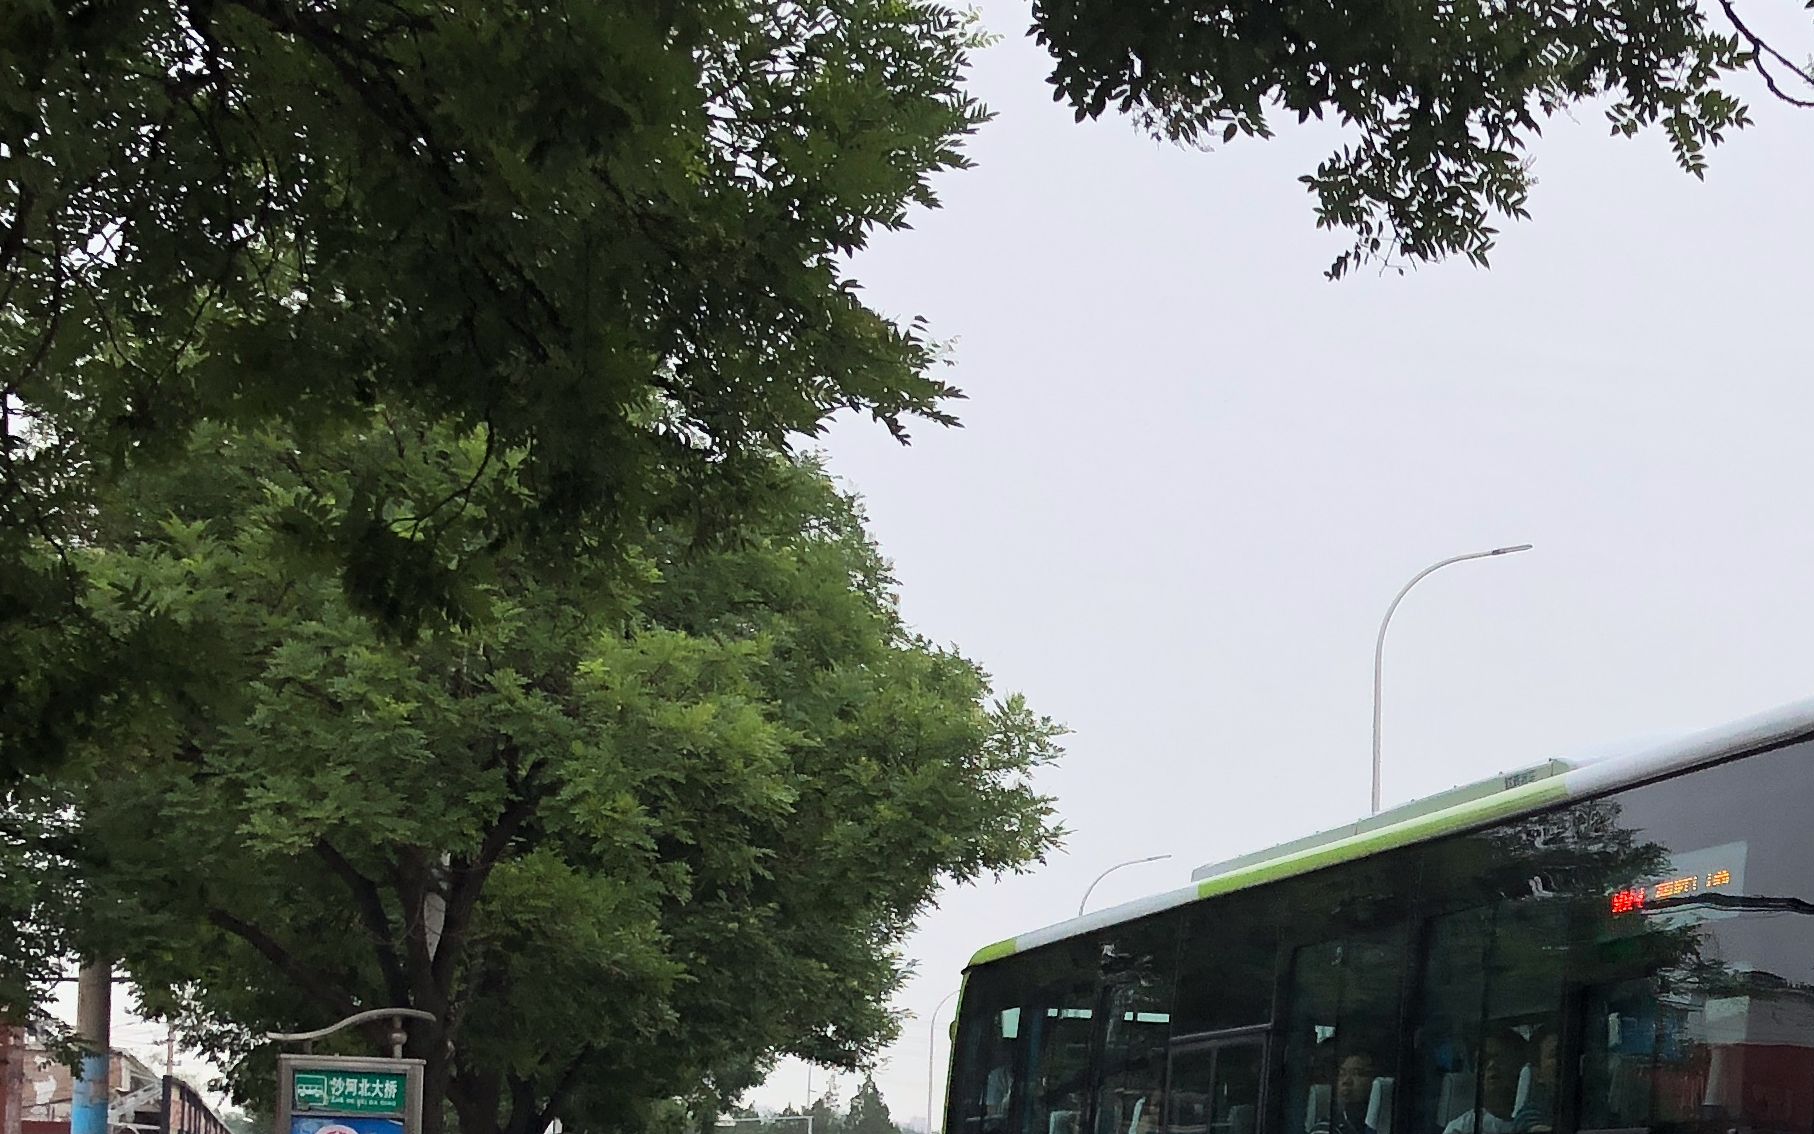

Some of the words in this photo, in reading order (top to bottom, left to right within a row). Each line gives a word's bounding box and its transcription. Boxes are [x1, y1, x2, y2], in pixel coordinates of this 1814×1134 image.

[328, 1076, 398, 1099] 沙河北大桥
